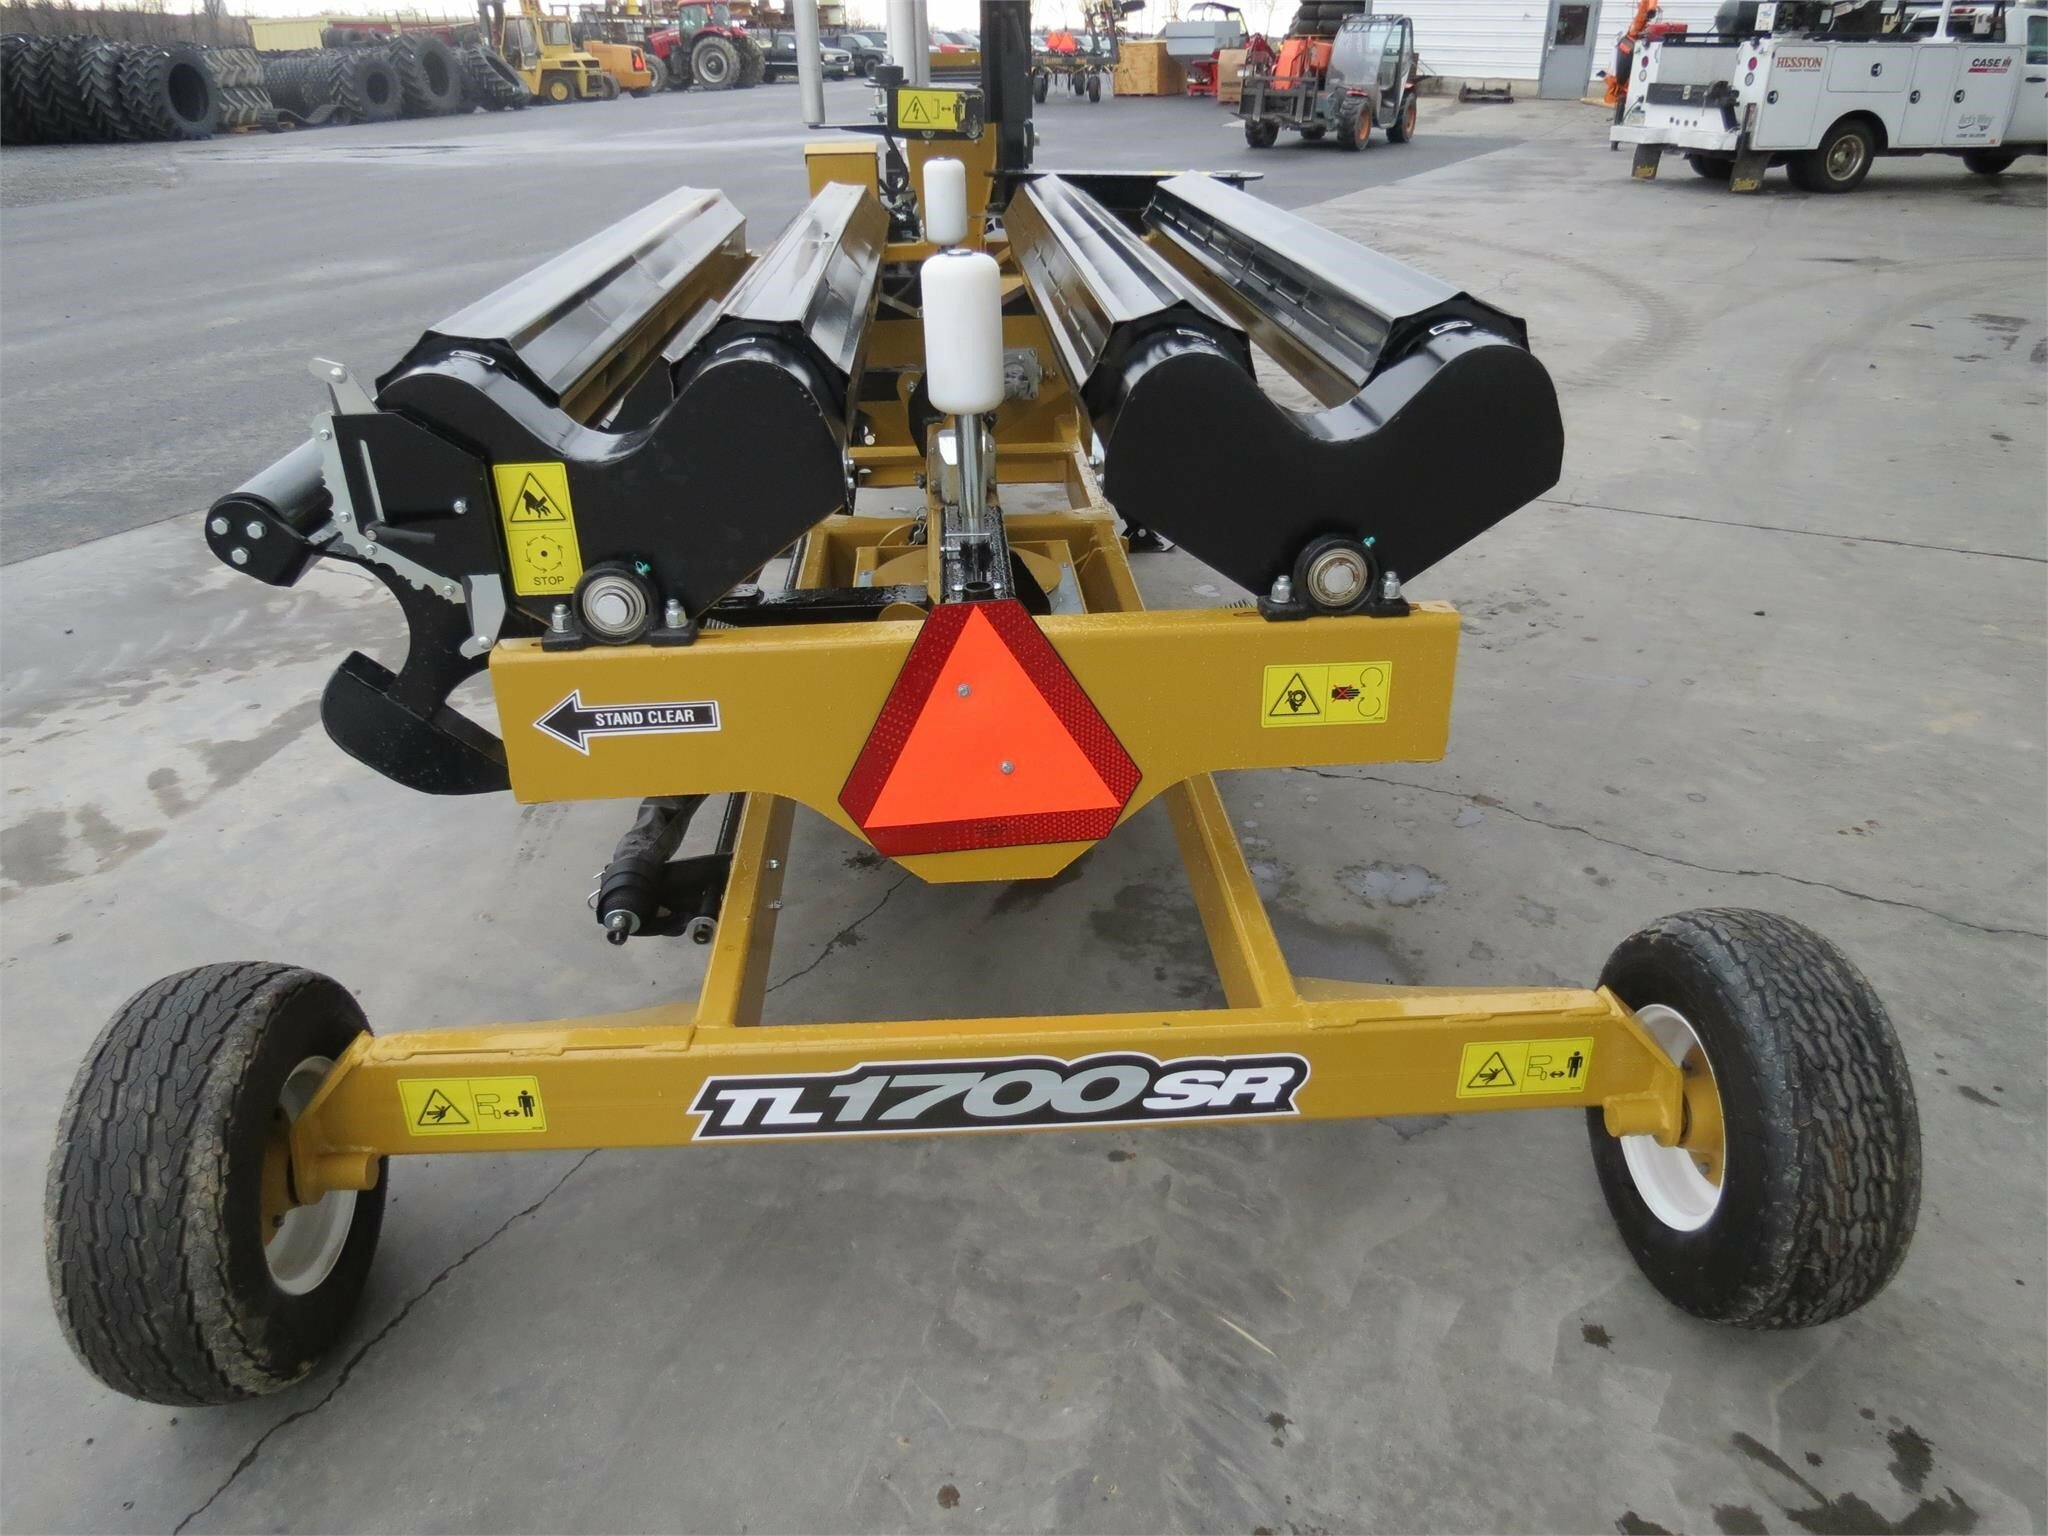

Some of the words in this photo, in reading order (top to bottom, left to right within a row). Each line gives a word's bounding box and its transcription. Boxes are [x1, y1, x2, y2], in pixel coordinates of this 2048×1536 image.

[1776, 56, 1823, 68] HESSTON
[1972, 58, 2001, 67] CASE
[533, 575, 565, 586] STOP
[595, 711, 644, 727] STAND
[648, 709, 695, 724] CLEAR
